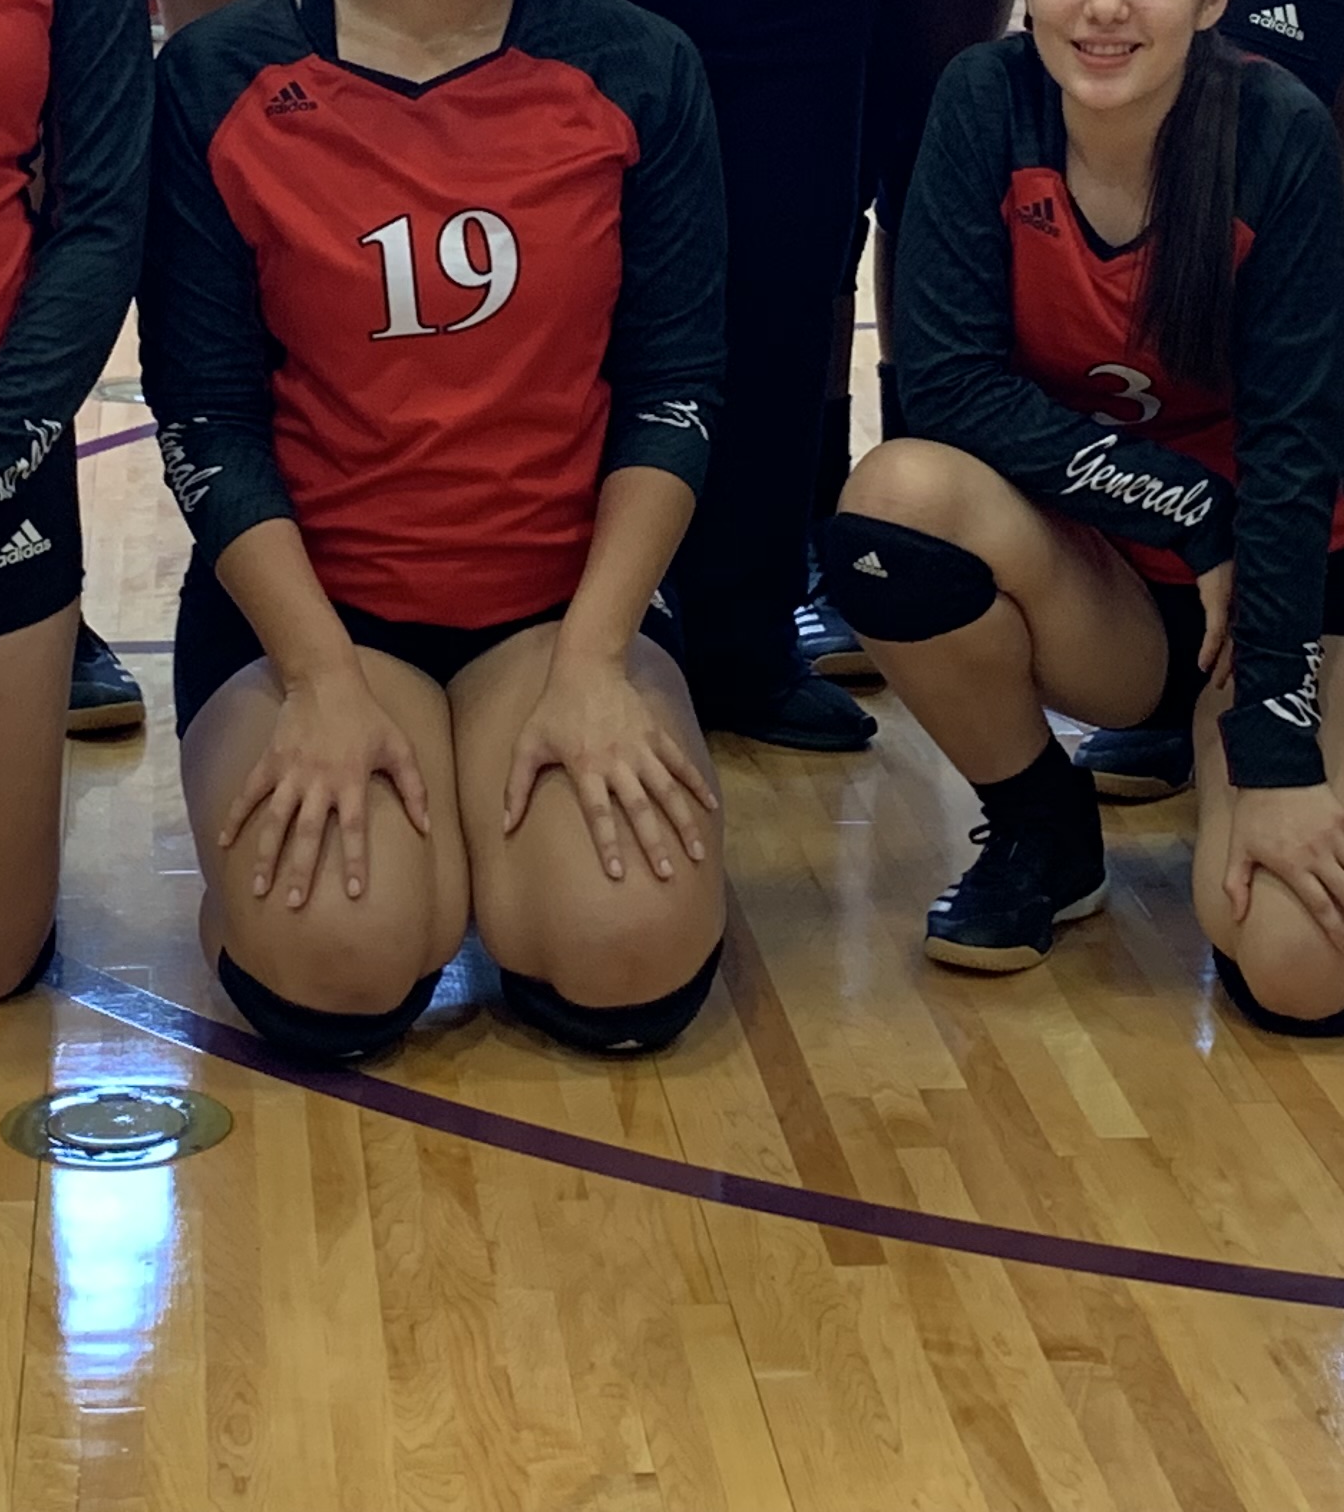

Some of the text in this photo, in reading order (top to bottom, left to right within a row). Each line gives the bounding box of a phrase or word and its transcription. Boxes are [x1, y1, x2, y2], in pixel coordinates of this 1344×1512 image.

[1248, 12, 1305, 42] adidas
[357, 206, 520, 341] 19
[1087, 362, 1163, 427] 3
[1059, 433, 1214, 528] Generals
